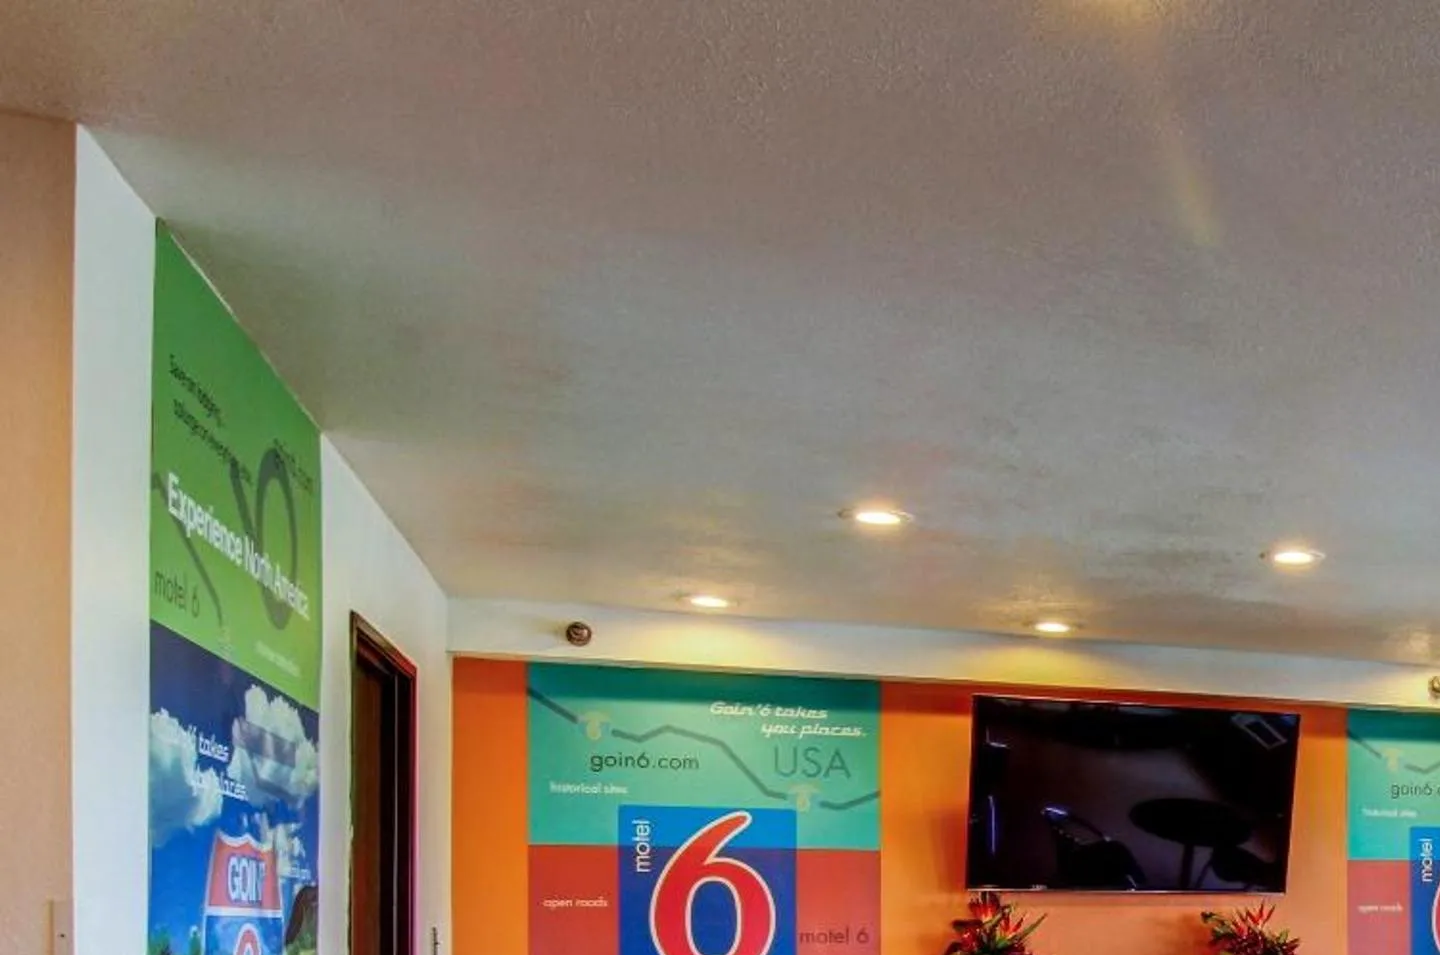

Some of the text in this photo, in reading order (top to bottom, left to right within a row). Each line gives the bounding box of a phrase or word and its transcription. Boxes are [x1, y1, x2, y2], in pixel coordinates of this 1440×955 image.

[168, 472, 244, 567] Experience
[154, 570, 200, 618] motel 6
[710, 702, 828, 719] Goin'6 takes
[762, 723, 797, 738] you
[590, 751, 700, 772] goin6.com
[774, 745, 851, 778] USA
[631, 819, 652, 873] motel
[1418, 837, 1433, 882] motel
[543, 899, 573, 911] open
[800, 928, 870, 946] motel 6
